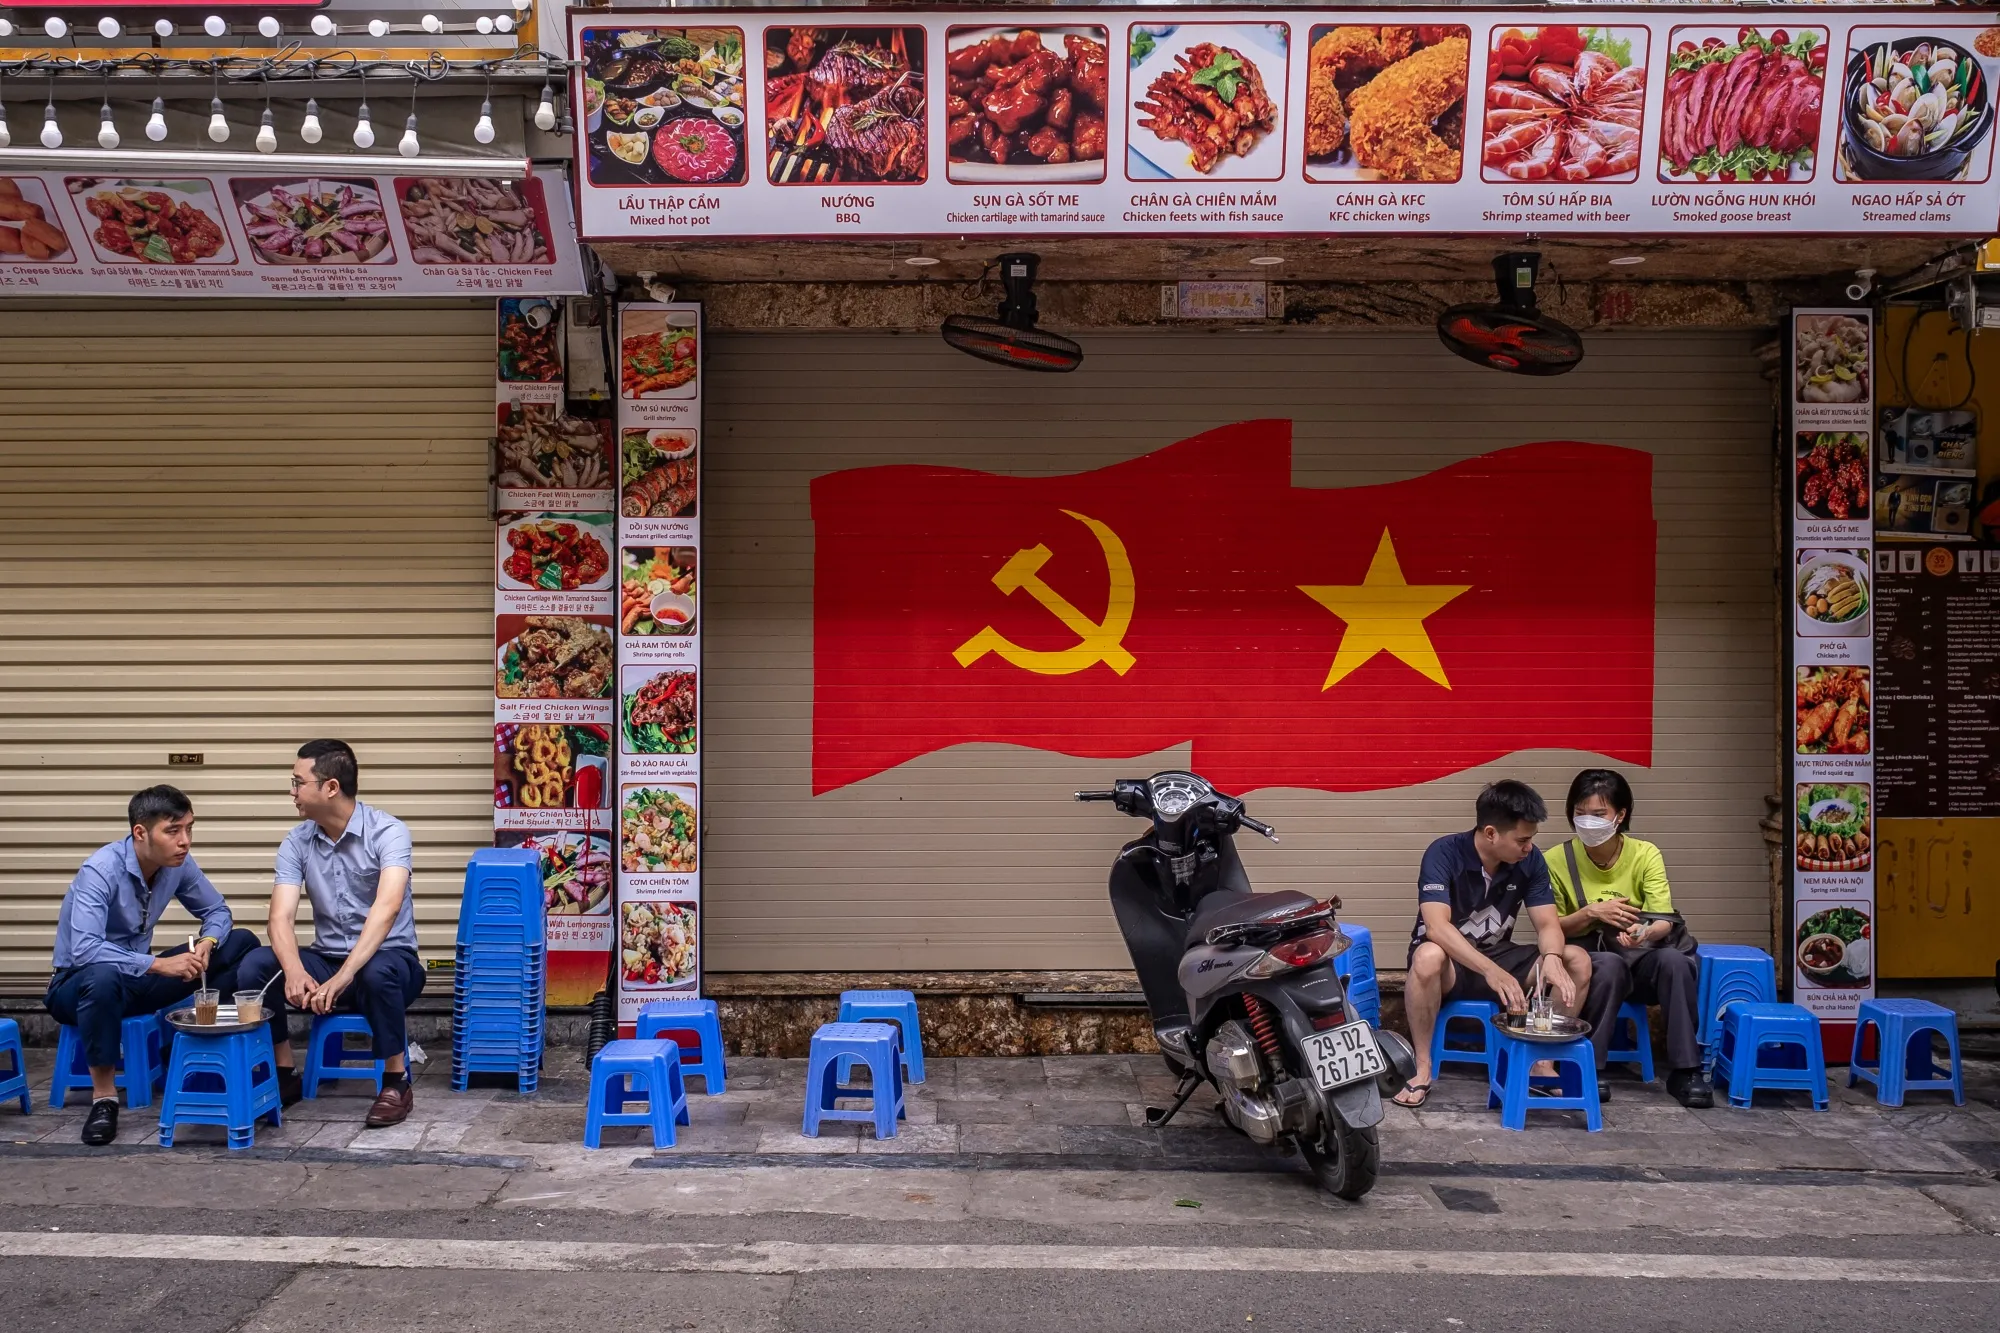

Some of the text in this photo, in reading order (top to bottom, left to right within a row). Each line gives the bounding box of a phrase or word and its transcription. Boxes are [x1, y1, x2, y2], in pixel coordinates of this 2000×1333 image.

[619, 193, 720, 212] LẨU THẬP CẨM
[821, 194, 875, 207] NƯỚNG
[973, 191, 1079, 208] SỤN GÀ SỐT ME
[1130, 190, 1277, 206] CHÂN GÀ CHIÊN MẮM
[1336, 192, 1426, 206] CÁNH GÀ KFC
[1502, 191, 1612, 206] TÔM SÚ HẤP BIA
[1651, 190, 1816, 206] LƯỜN NGỖNG HUN KHÓI
[1852, 191, 1966, 206] NGAO HẤP SẢ ỚT
[630, 215, 710, 227] Mixed hot pot
[836, 213, 861, 224] BBQ
[946, 212, 979, 222] Chicken
[981, 212, 1018, 224] cartilage
[1019, 212, 1039, 222] with
[1040, 212, 1079, 221] tamarind
[1123, 212, 1166, 221] Chicken
[1169, 211, 1197, 221] feets
[1200, 211, 1225, 221] with
[1229, 211, 1249, 221] fish
[1329, 211, 1430, 223] KFC chicken wings
[1482, 211, 1631, 223] Shrimp steamed with beer
[1672, 211, 1792, 223] Smoked goose breast
[1862, 211, 1951, 221] Streamed clams
[52, 267, 84, 275] Sticks
[508, 384, 522, 392] Fried
[524, 384, 547, 392] Chicken
[547, 384, 560, 392] Feet
[630, 404, 648, 412] TÔM
[499, 703, 611, 713] Salt Fried Chicken Wings
[1850, 877, 1864, 885] NỘI
[549, 920, 610, 930] With Lemongrass
[1807, 993, 1821, 1001] BÚN
[1822, 992, 1837, 1000] CHẢ
[1848, 994, 1861, 1002] NỘI
[1313, 1027, 1366, 1061] 29-D2
[1317, 1048, 1380, 1087] 267.25
